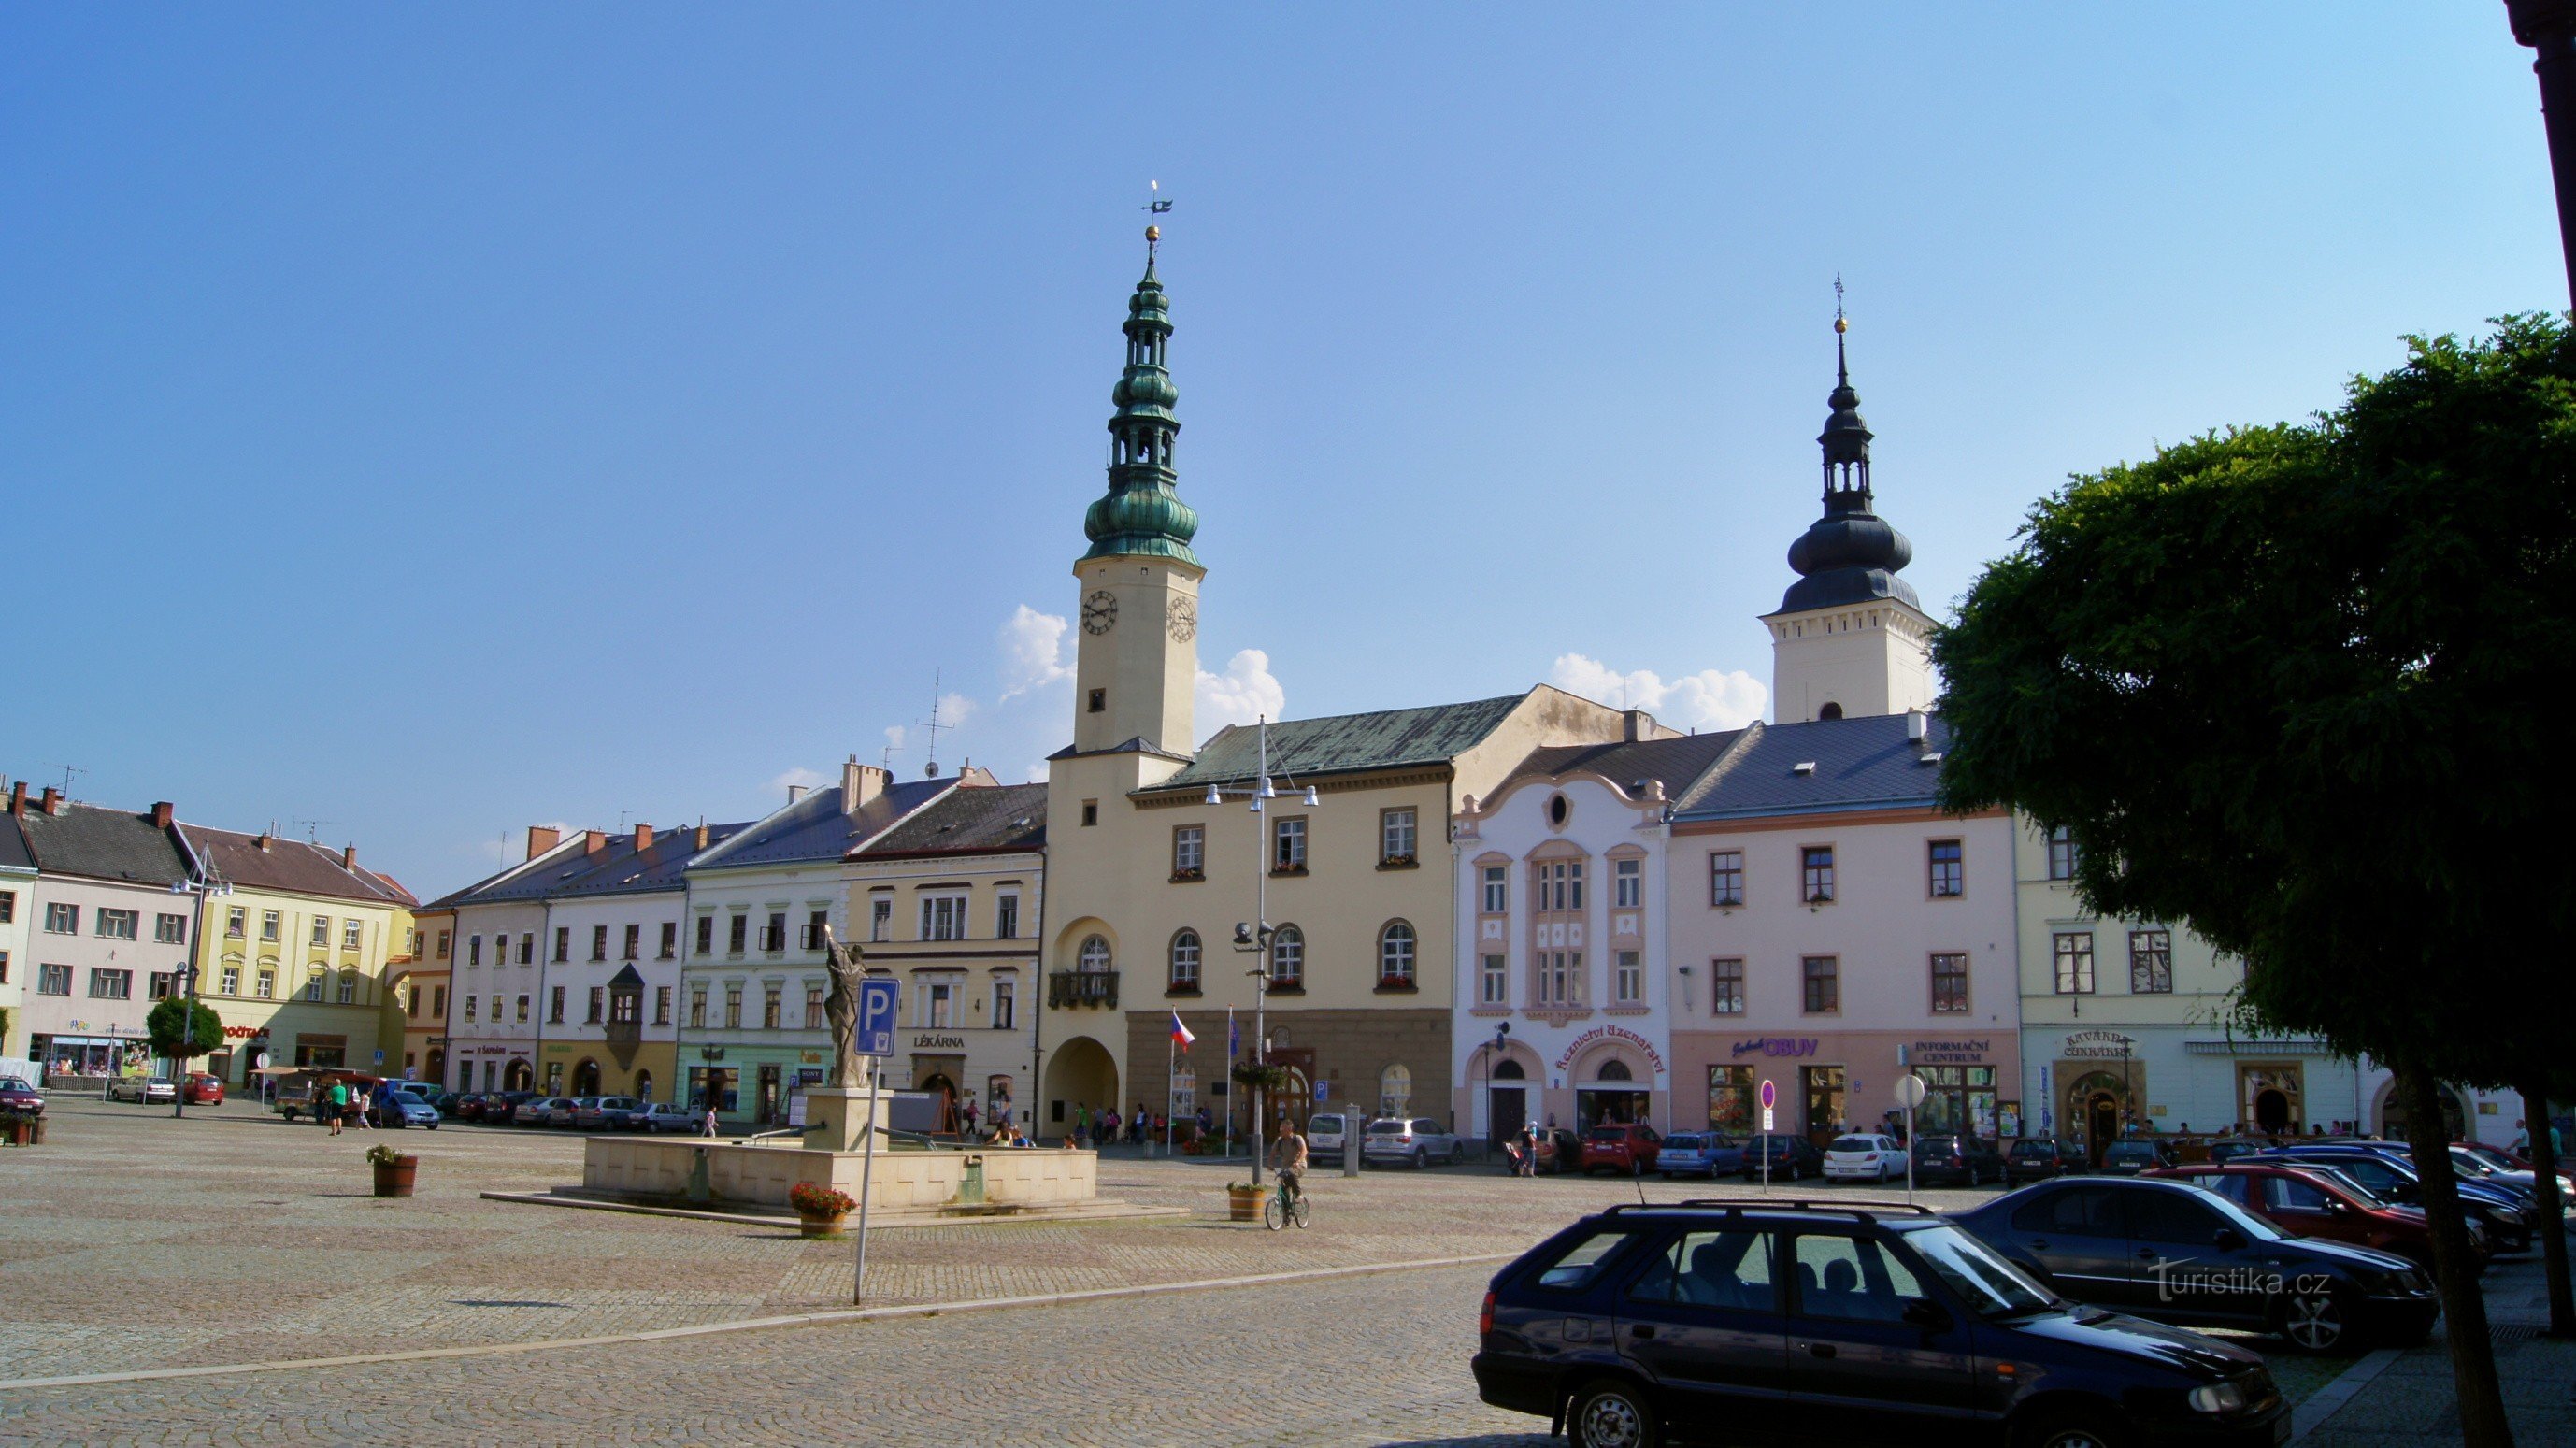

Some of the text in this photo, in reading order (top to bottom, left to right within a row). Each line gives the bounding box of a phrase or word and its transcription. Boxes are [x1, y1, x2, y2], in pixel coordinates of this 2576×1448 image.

[866, 989, 889, 1031] P
[913, 1034, 965, 1048] LÉKÁRNA
[1764, 1038, 1818, 1057] OBUV
[1915, 1039, 1990, 1051] INFORMAČNÍ
[1924, 1053, 1982, 1062] CENTRUM
[1318, 1082, 1324, 1095] P
